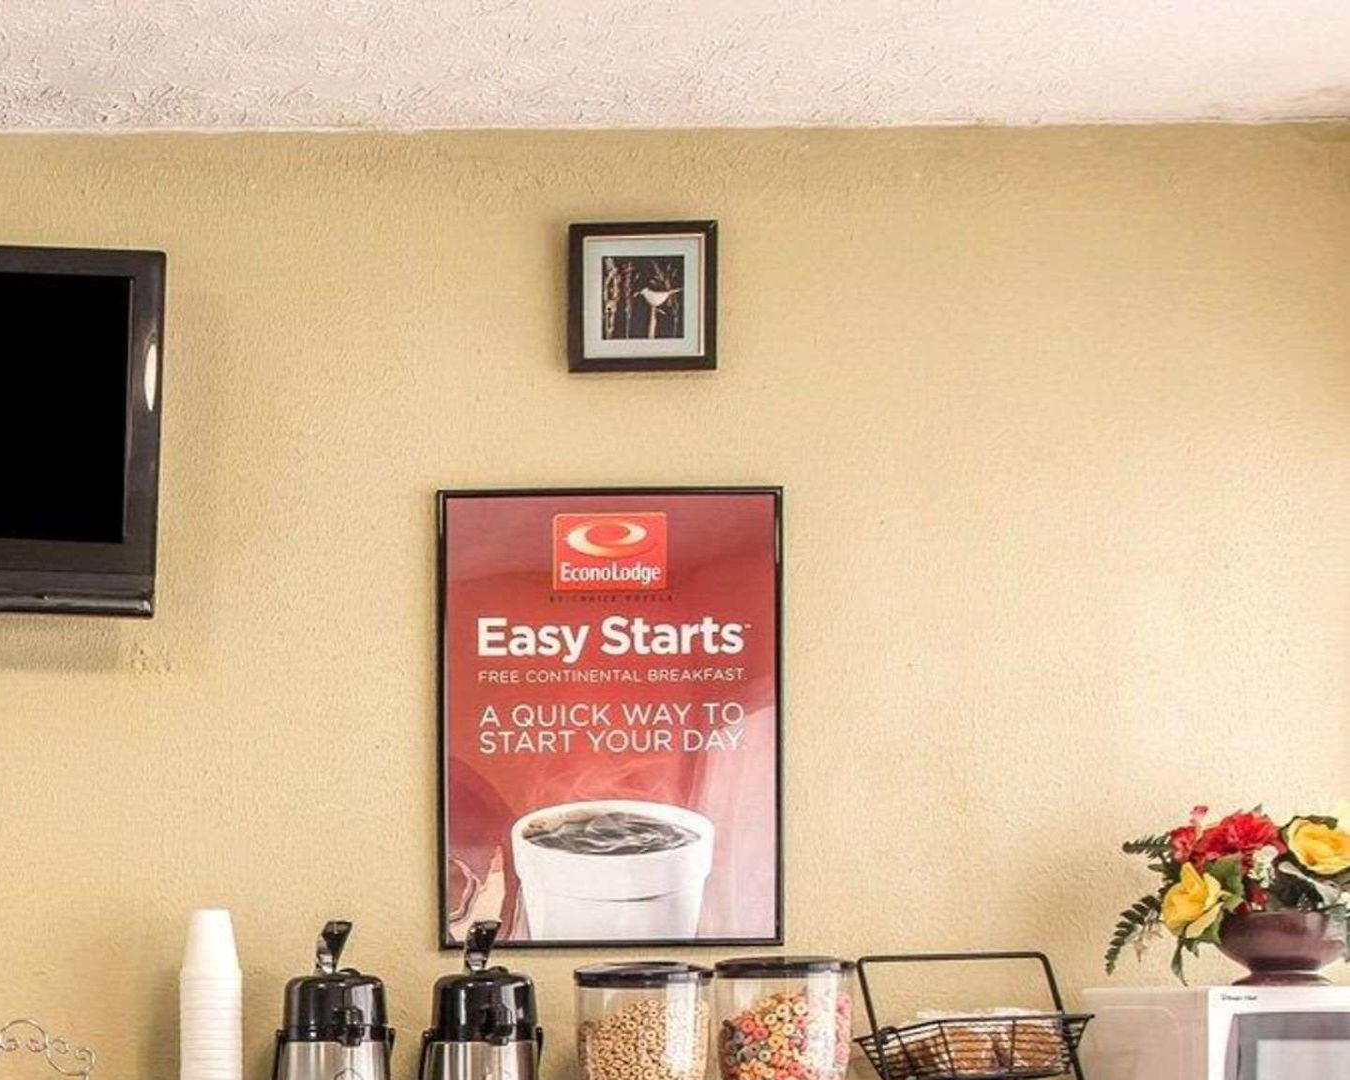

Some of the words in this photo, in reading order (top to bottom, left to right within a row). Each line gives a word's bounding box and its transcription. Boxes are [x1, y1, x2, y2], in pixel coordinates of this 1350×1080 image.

[477, 617, 590, 663] Easy
[478, 671, 519, 683] FREE
[526, 670, 641, 683] CONTINENTAL
[479, 706, 500, 727] A
[512, 705, 611, 728] QUICK
[622, 704, 692, 726] WAY
[704, 703, 745, 725] TO
[479, 733, 575, 754] START
[587, 731, 672, 752] YOUR
